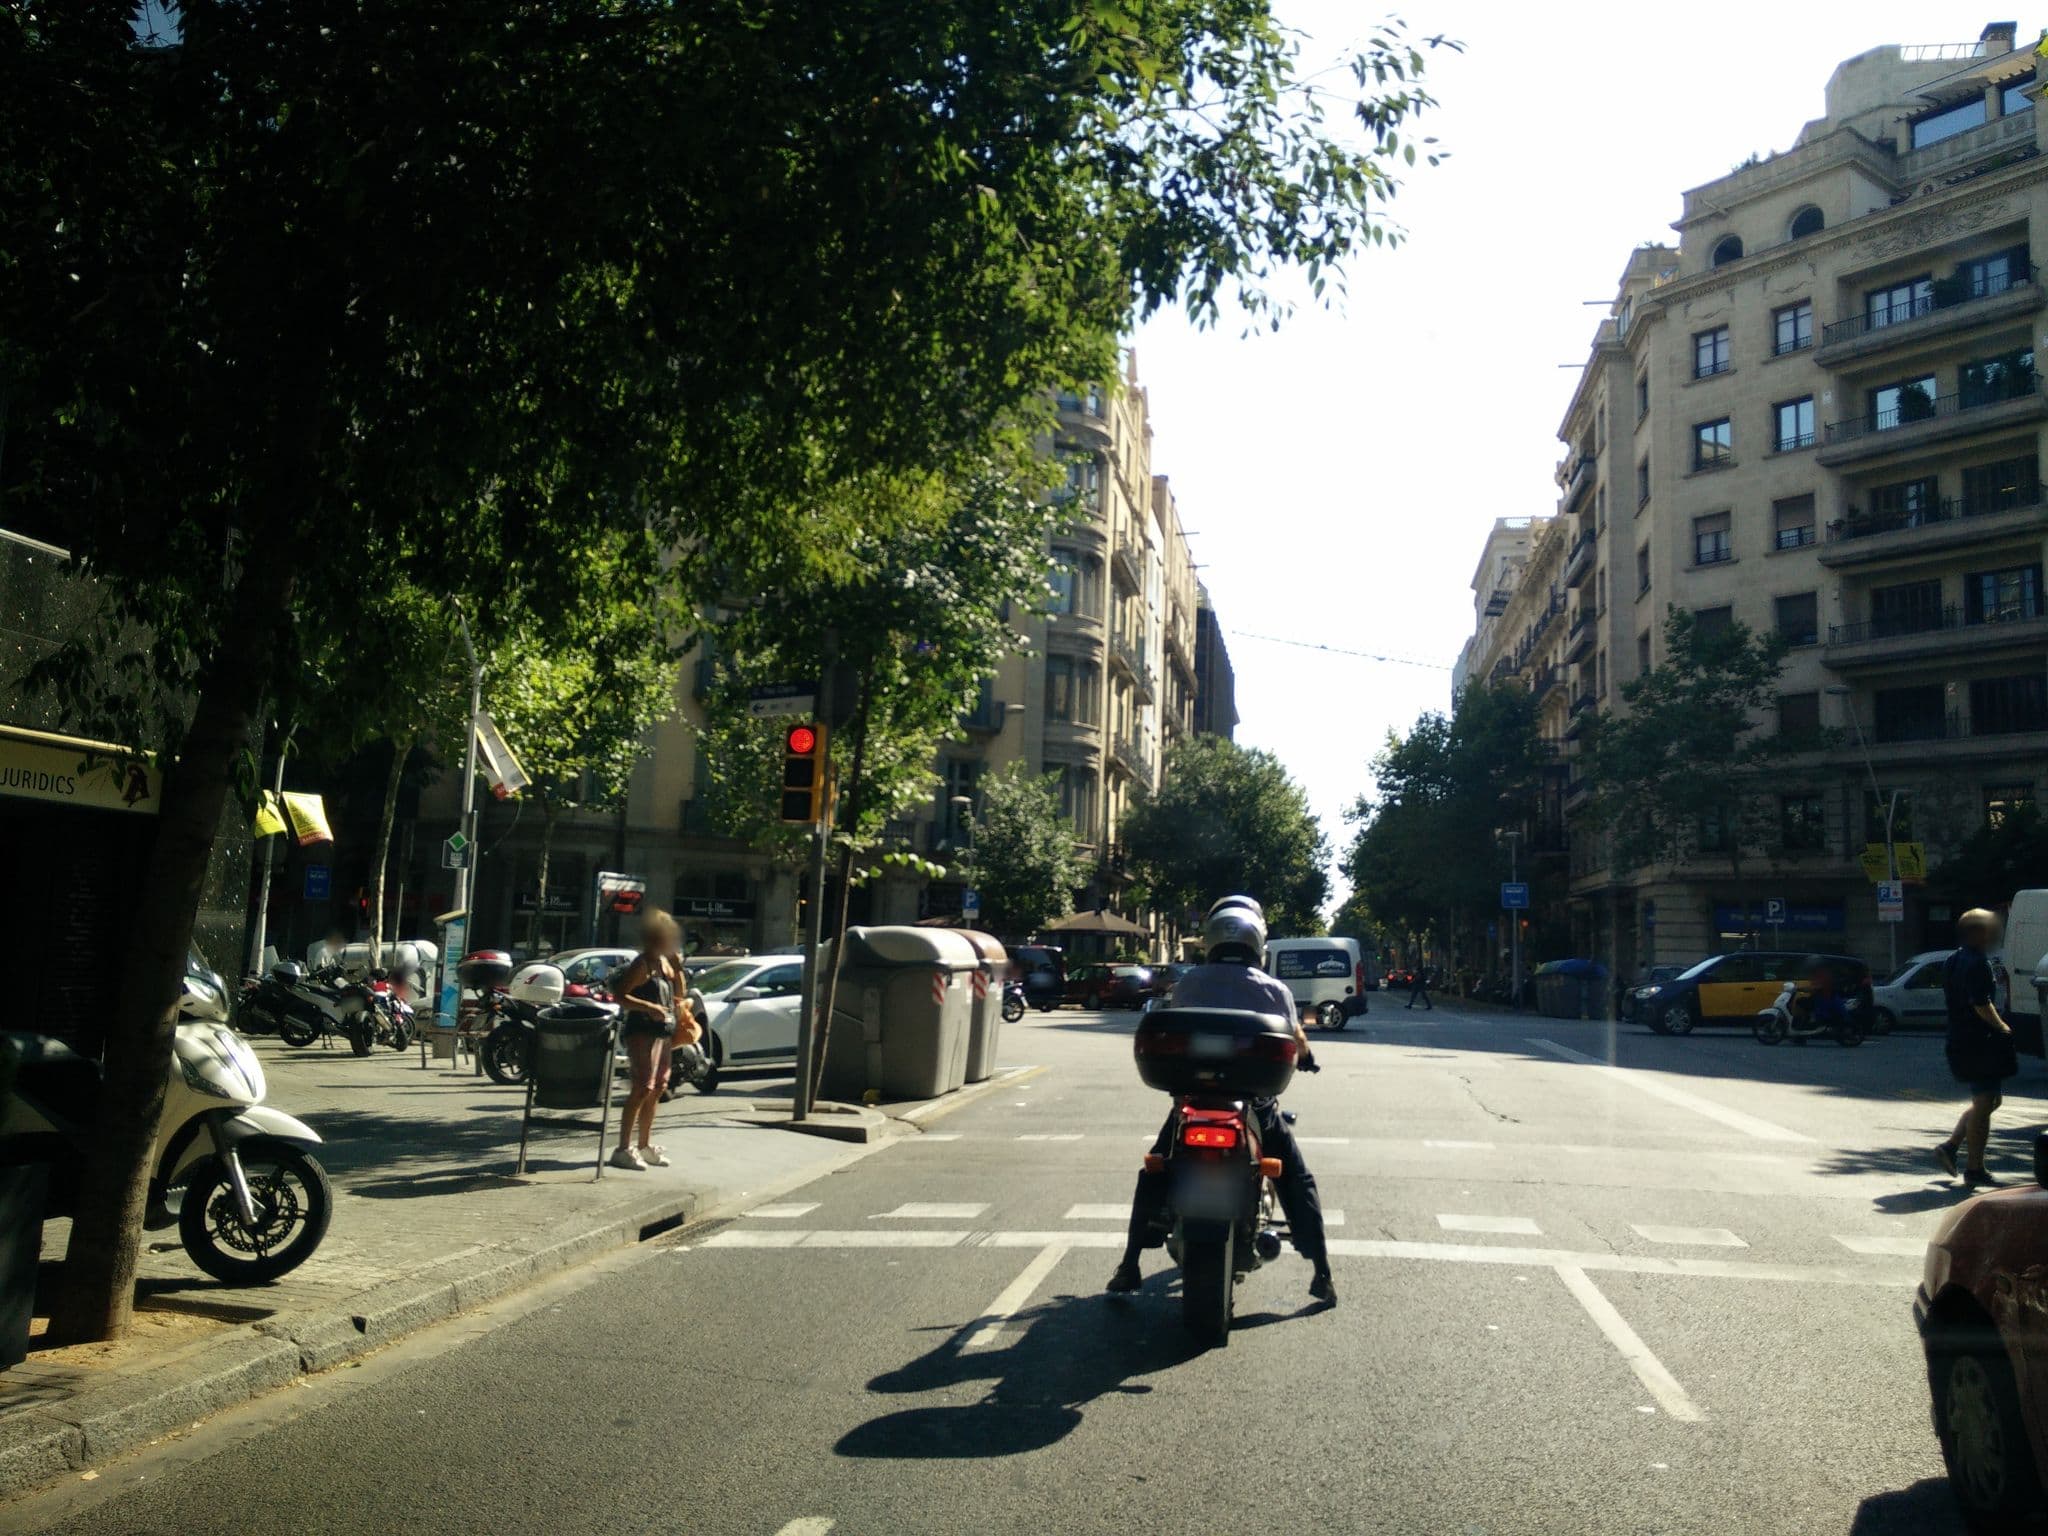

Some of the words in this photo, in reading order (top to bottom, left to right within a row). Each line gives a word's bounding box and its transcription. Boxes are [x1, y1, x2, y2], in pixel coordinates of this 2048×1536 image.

[0, 767, 75, 795] JURIDICS
[966, 892, 977, 907] P
[1768, 900, 1780, 917] P
